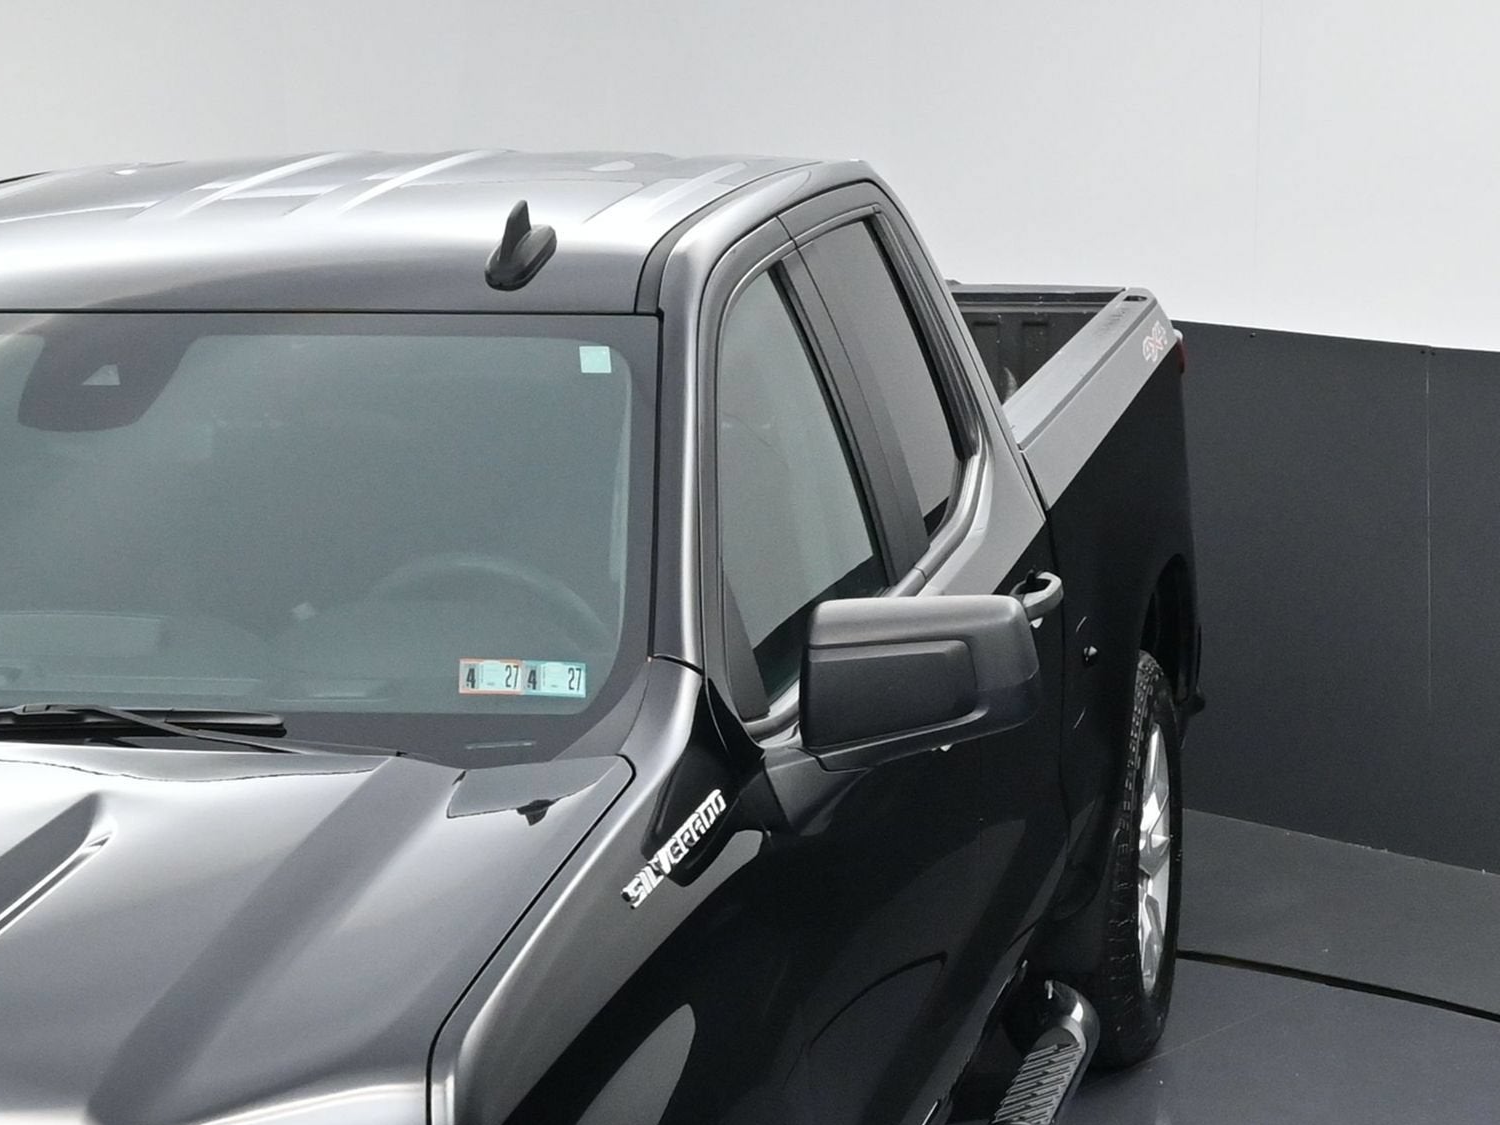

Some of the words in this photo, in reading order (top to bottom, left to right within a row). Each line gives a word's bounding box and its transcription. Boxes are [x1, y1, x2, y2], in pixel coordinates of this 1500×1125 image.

[466, 668, 476, 689] 4
[505, 665, 519, 690] 27
[527, 669, 537, 690] 4
[567, 667, 582, 692] 27
[621, 788, 727, 909] SILVERADO
